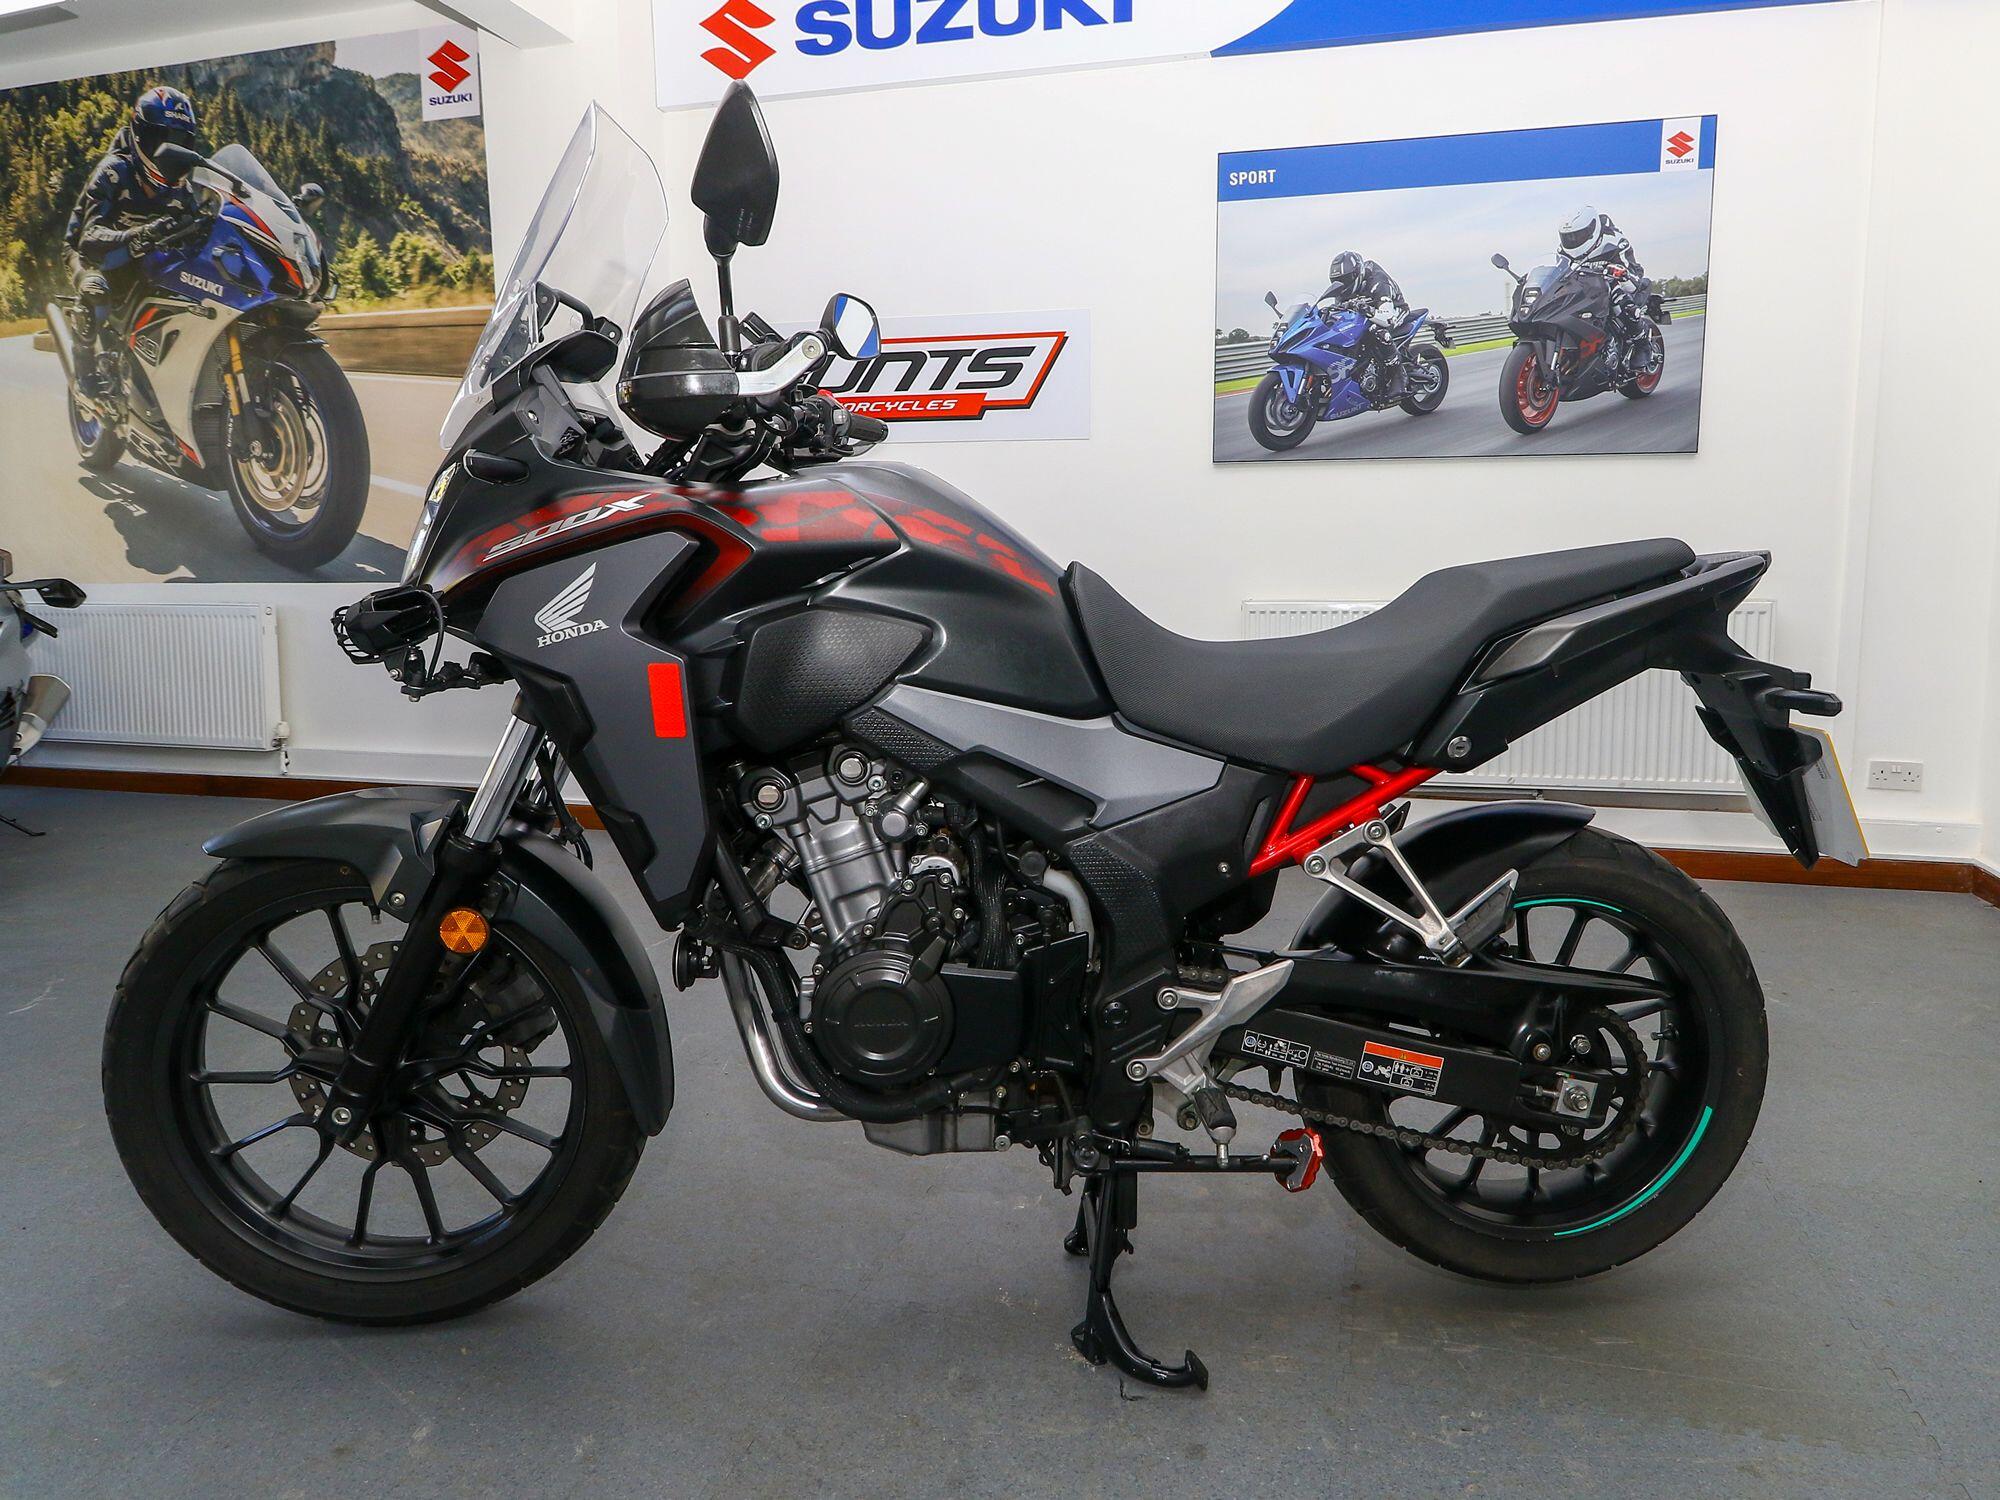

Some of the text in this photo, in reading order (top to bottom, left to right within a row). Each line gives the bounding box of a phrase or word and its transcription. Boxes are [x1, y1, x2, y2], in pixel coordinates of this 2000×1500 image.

[429, 93, 473, 106] SUZUKI
[1229, 169, 1276, 186] SPORT
[180, 271, 223, 297] SUZUKI
[806, 346, 1036, 393] UNTS
[845, 399, 958, 412] ORCYCLES
[536, 619, 610, 648] HONDA
